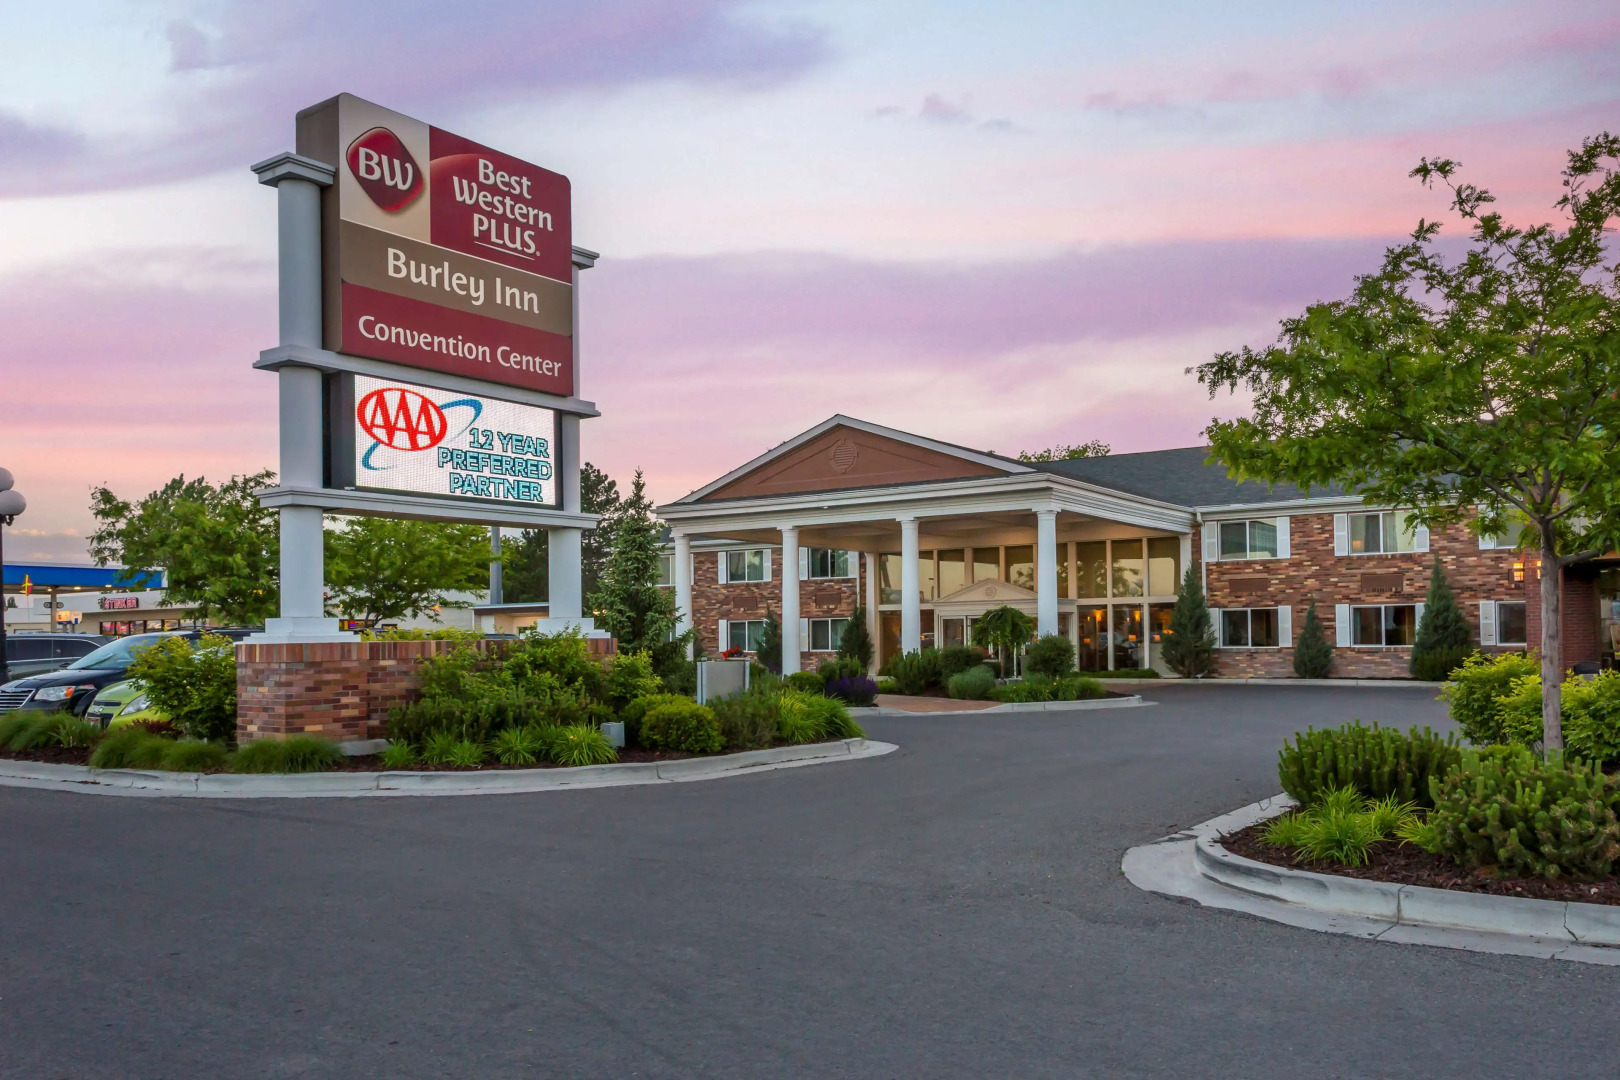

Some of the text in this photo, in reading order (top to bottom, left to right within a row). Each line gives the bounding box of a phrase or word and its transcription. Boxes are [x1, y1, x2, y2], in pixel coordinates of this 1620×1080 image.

[358, 146, 413, 191] BW
[478, 158, 532, 199] Best
[452, 175, 554, 232] Western
[473, 213, 537, 256] PLUS
[387, 247, 540, 314] Burley Inn
[358, 315, 562, 377] Convention Center
[369, 390, 439, 450] AAA
[438, 447, 552, 480] PREFERRED
[469, 428, 549, 458] 12 YEAR
[450, 472, 543, 502] PARTNER
